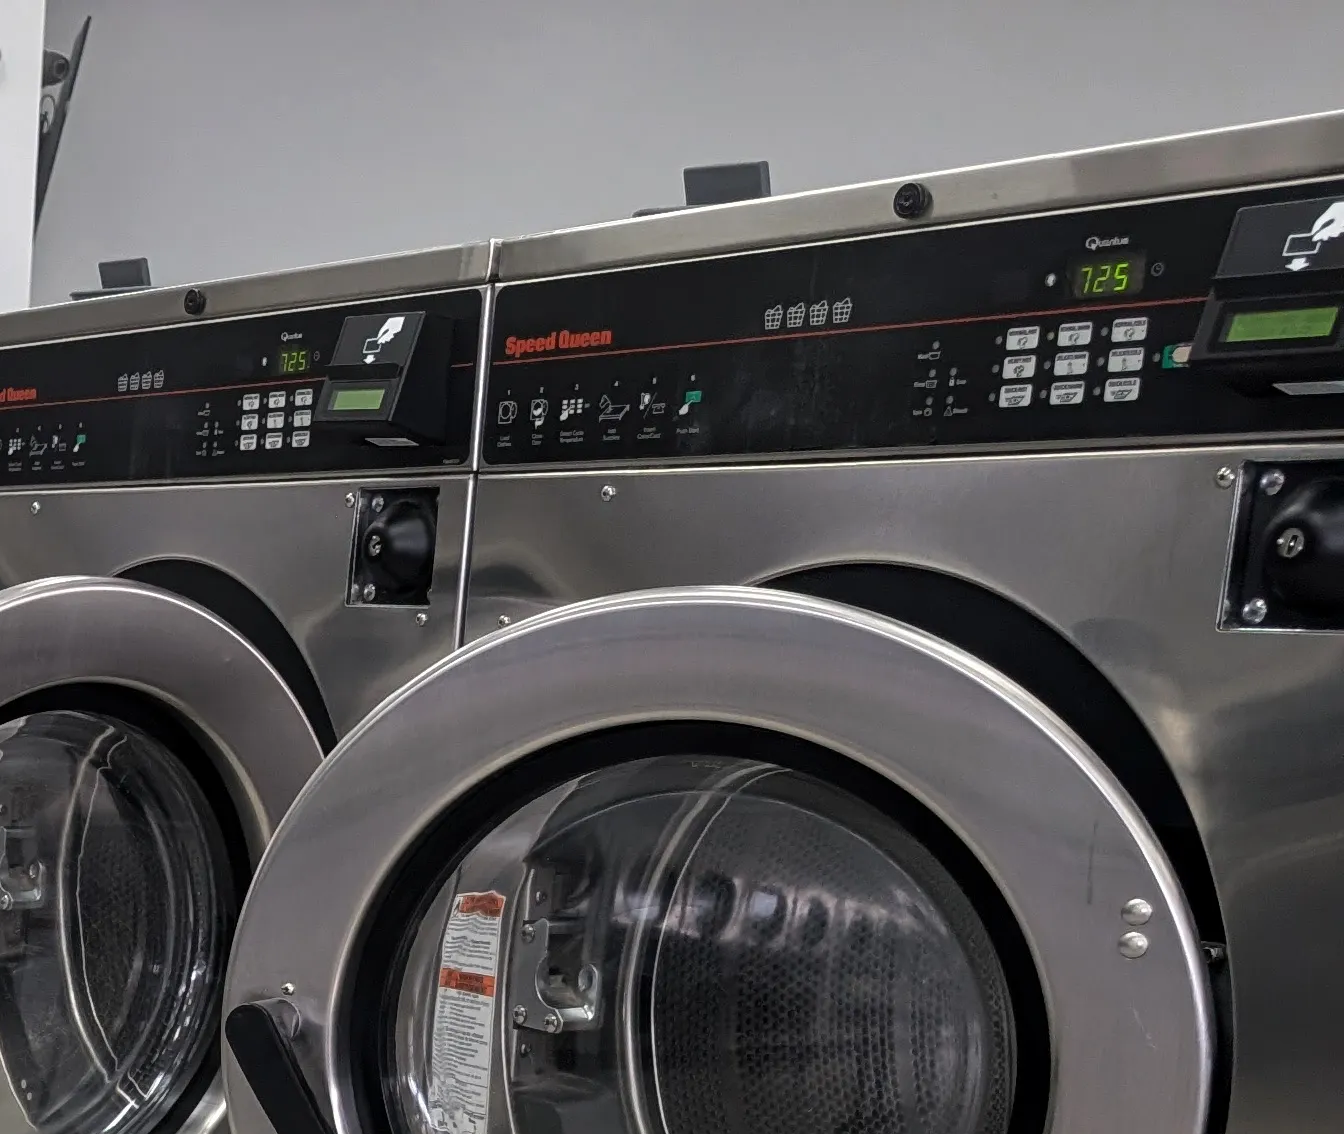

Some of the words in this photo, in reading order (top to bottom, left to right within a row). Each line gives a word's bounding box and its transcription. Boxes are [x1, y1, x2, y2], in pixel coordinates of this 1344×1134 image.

[1081, 263, 1129, 294] 725
[505, 332, 557, 358] Speed
[558, 330, 612, 350] Queen
[7, 387, 37, 401] Queen
